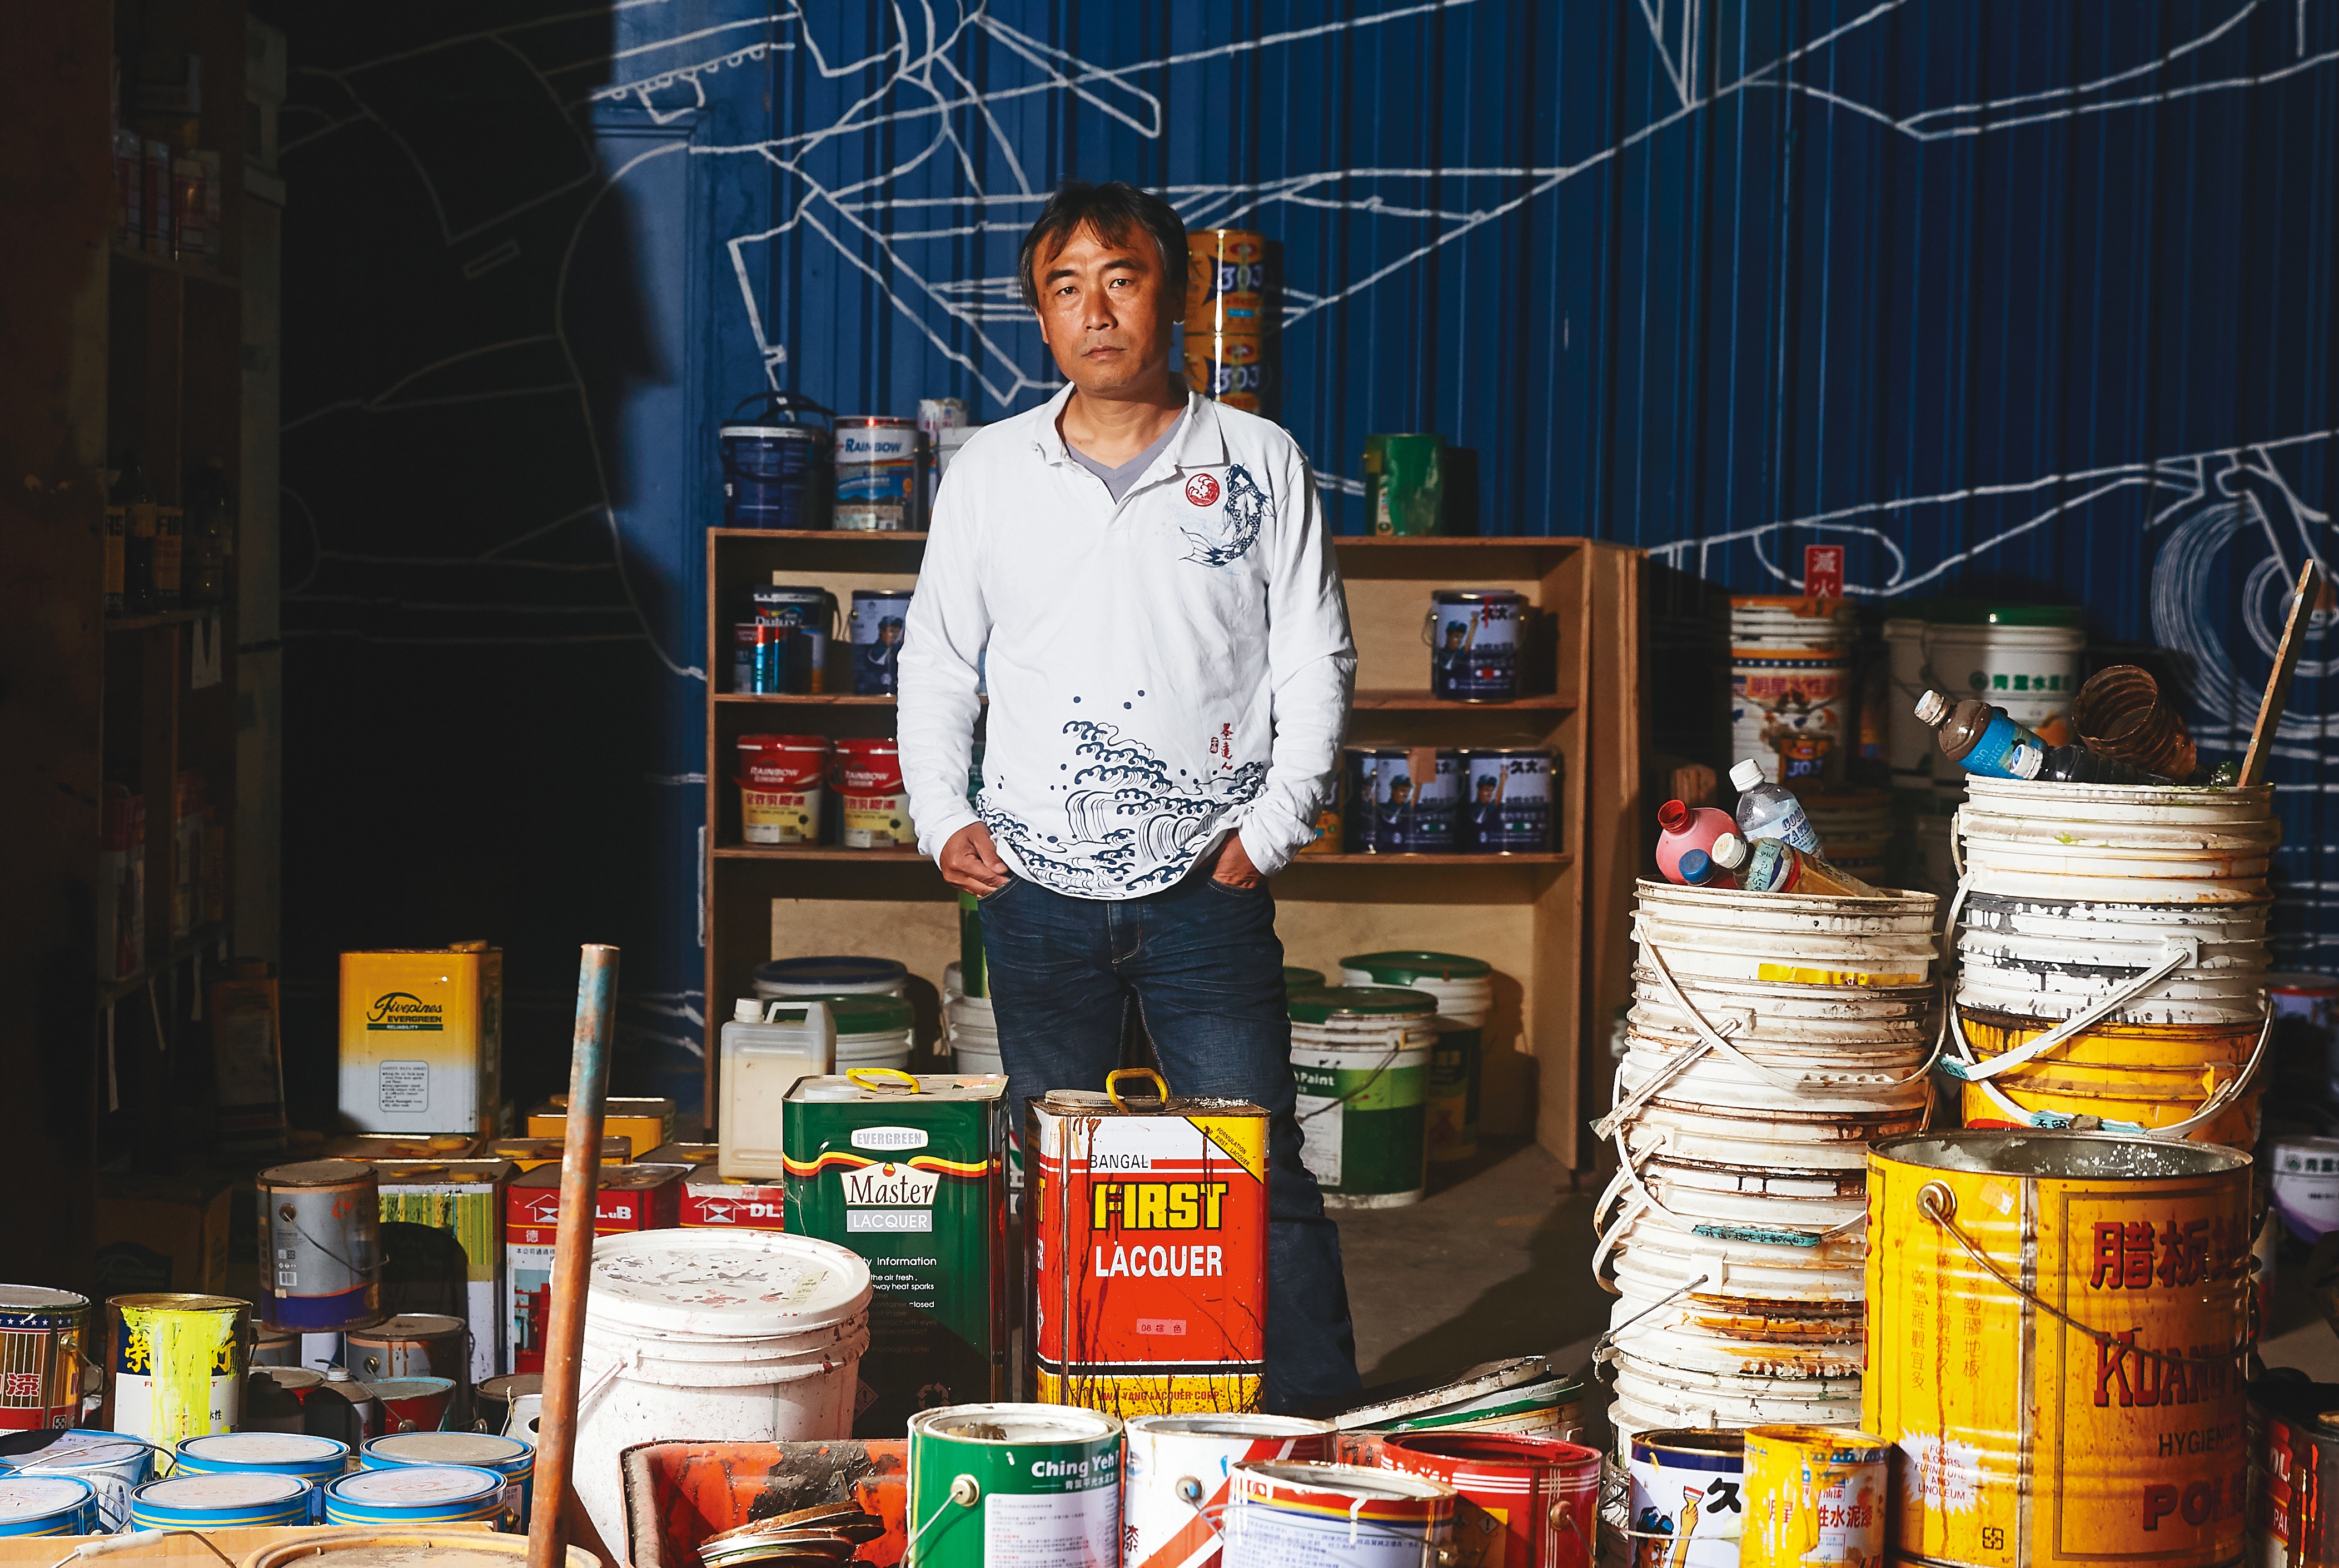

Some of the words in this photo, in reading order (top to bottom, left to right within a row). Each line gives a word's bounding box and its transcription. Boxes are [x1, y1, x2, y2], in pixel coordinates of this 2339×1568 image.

[845, 438, 903, 452] RAINBOW
[367, 992, 442, 1022] Fivepines
[1301, 1072, 1335, 1086] Paint
[857, 1133, 922, 1145] EVERGREEN
[1216, 1127, 1247, 1154] FORMULATION
[1215, 1135, 1228, 1147] FIRST
[1230, 1148, 1250, 1167] LACQUER
[1090, 1154, 1148, 1169] BANGAL
[848, 1174, 933, 1204] Master
[596, 1204, 631, 1219] LuB
[750, 1203, 784, 1218] DL
[1092, 1181, 1229, 1231] FIRST
[854, 1214, 928, 1228] LACQUER
[877, 1256, 937, 1266] Information
[1096, 1245, 1223, 1277] LACQUER
[1156, 1324, 1164, 1333] 棕
[1173, 1325, 1182, 1333] 色
[1123, 1391, 1147, 1400] YANG
[1150, 1391, 1192, 1400] LACQUER
[1195, 1391, 1220, 1400] CORP
[1930, 1445, 1949, 1456] FOR
[1031, 1460, 1089, 1479] Ching
[1091, 1453, 1114, 1472] Yeh
[1922, 1453, 1960, 1467] FLOORS
[1914, 1462, 1967, 1480] FURNITURE
[1931, 1476, 1950, 1487] AND
[1918, 1483, 1965, 1500] LINOLEUM
